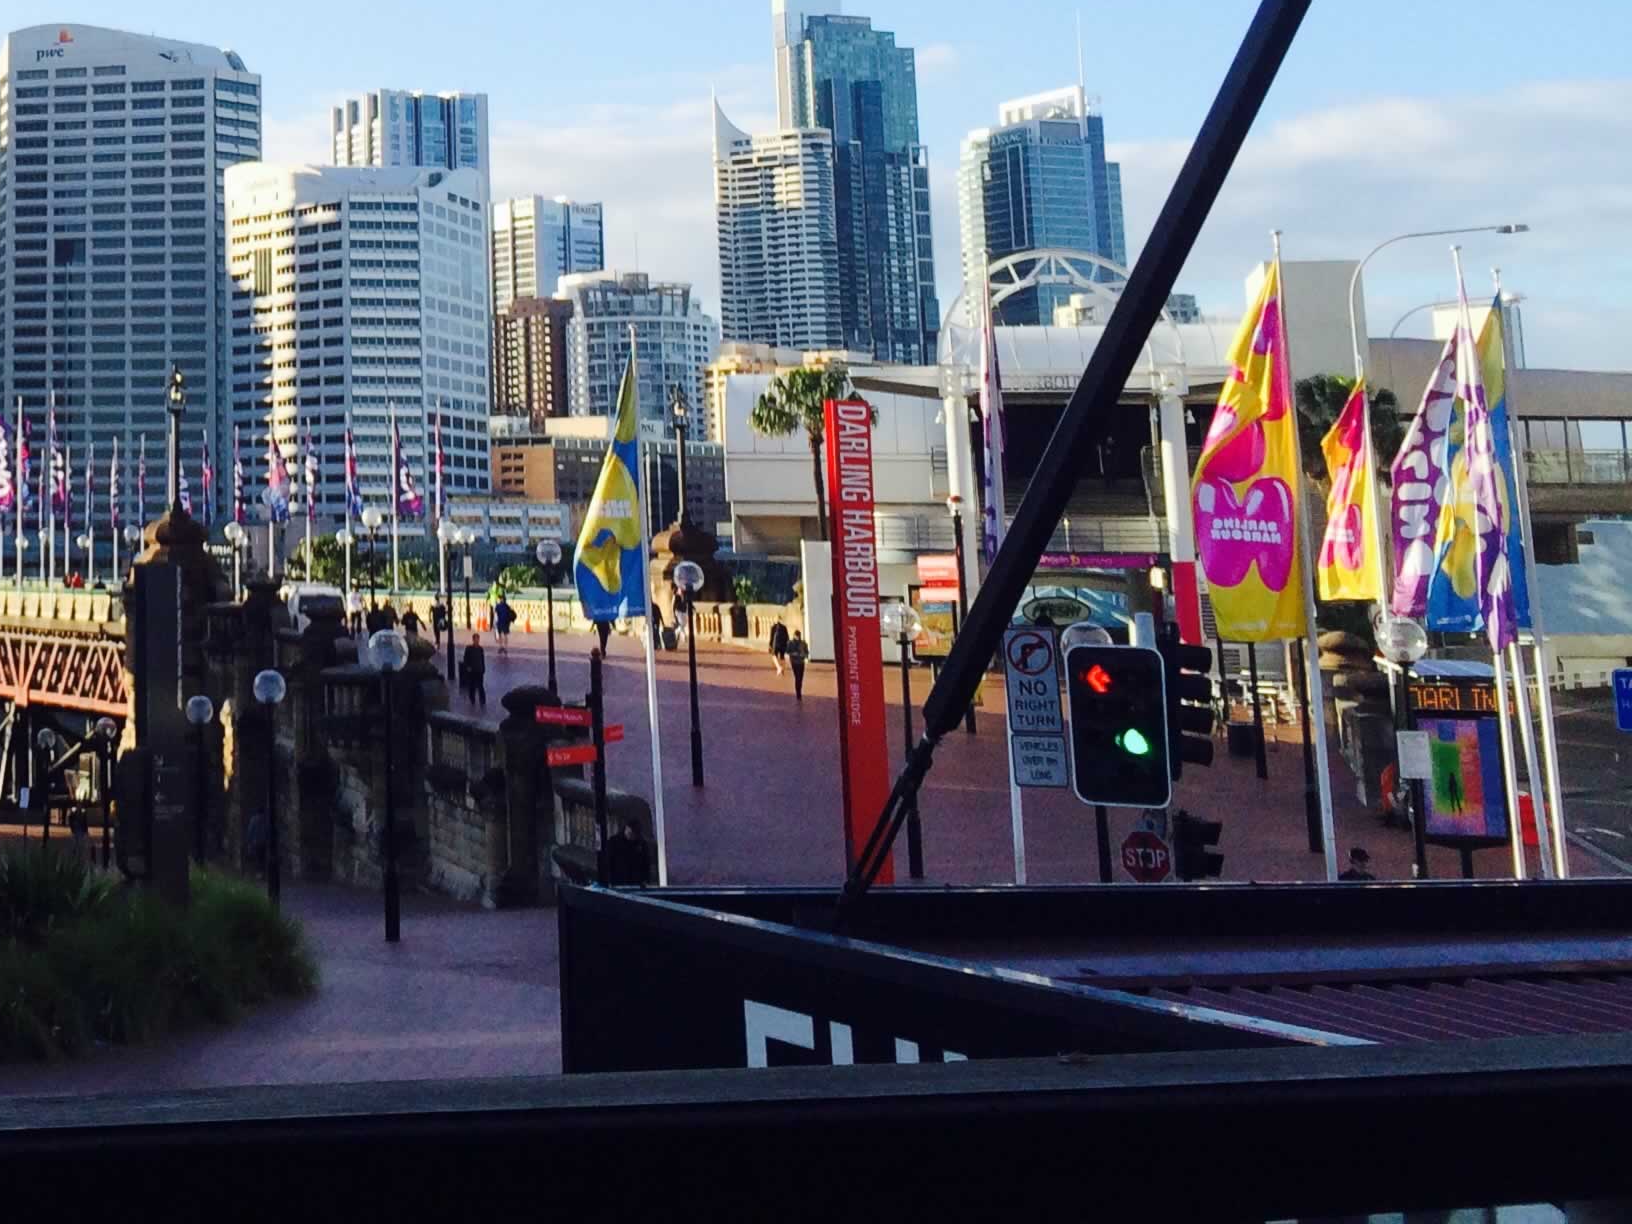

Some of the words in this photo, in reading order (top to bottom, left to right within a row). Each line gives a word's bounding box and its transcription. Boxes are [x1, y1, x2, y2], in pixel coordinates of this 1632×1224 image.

[36, 48, 64, 61] pwc
[837, 404, 871, 502] DARLING
[842, 509, 877, 618] HARBOUR
[848, 626, 859, 683] PYRMONT
[1019, 680, 1047, 696] NO
[850, 685, 861, 724] BRIDGE
[1015, 700, 1056, 711] RIGHT
[1017, 715, 1055, 726] TURN
